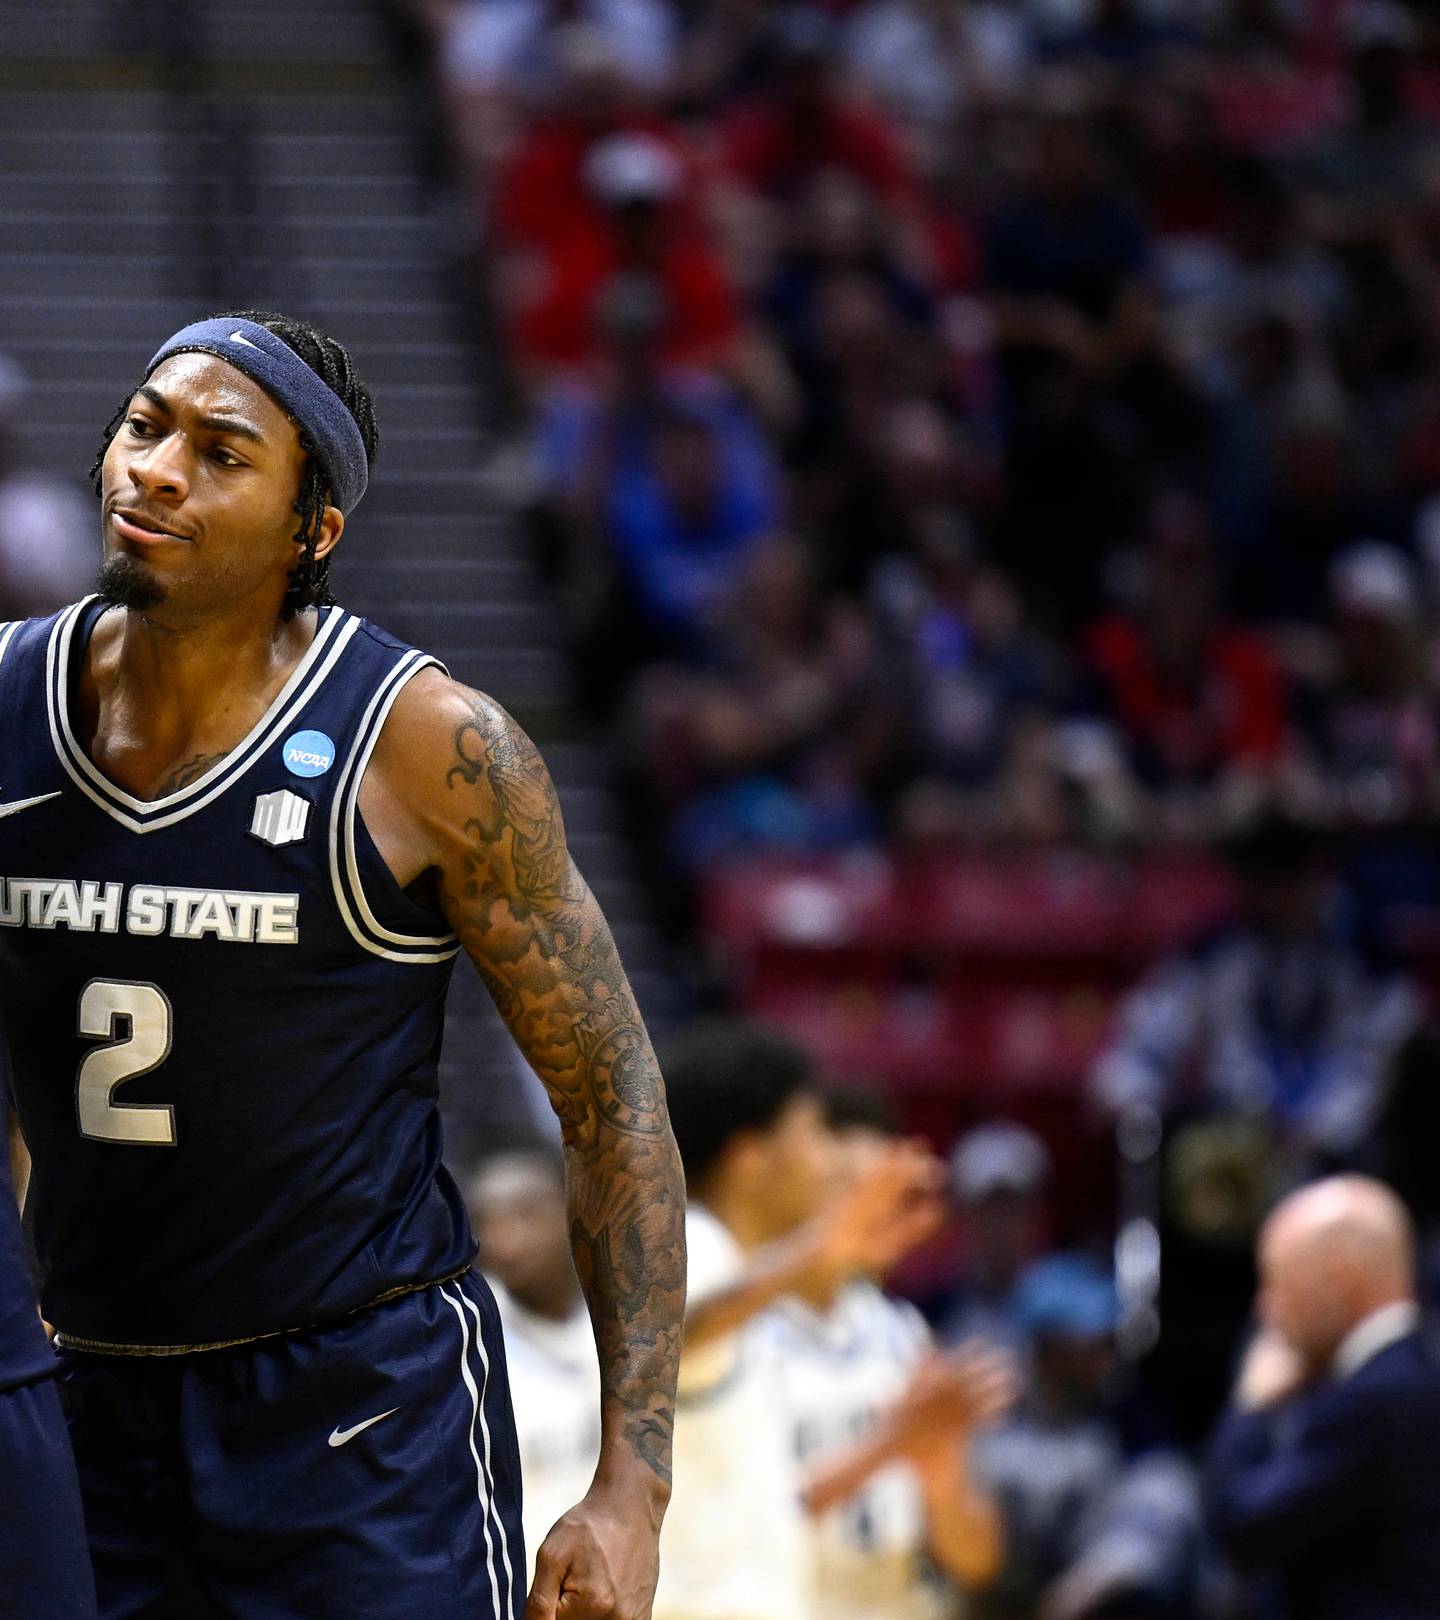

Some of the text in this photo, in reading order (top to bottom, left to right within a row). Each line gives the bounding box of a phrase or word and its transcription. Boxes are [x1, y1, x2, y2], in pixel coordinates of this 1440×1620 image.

[288, 748, 331, 769] NCAA
[250, 789, 311, 845] MW
[126, 884, 300, 945] STATE
[75, 976, 178, 1147] 2
